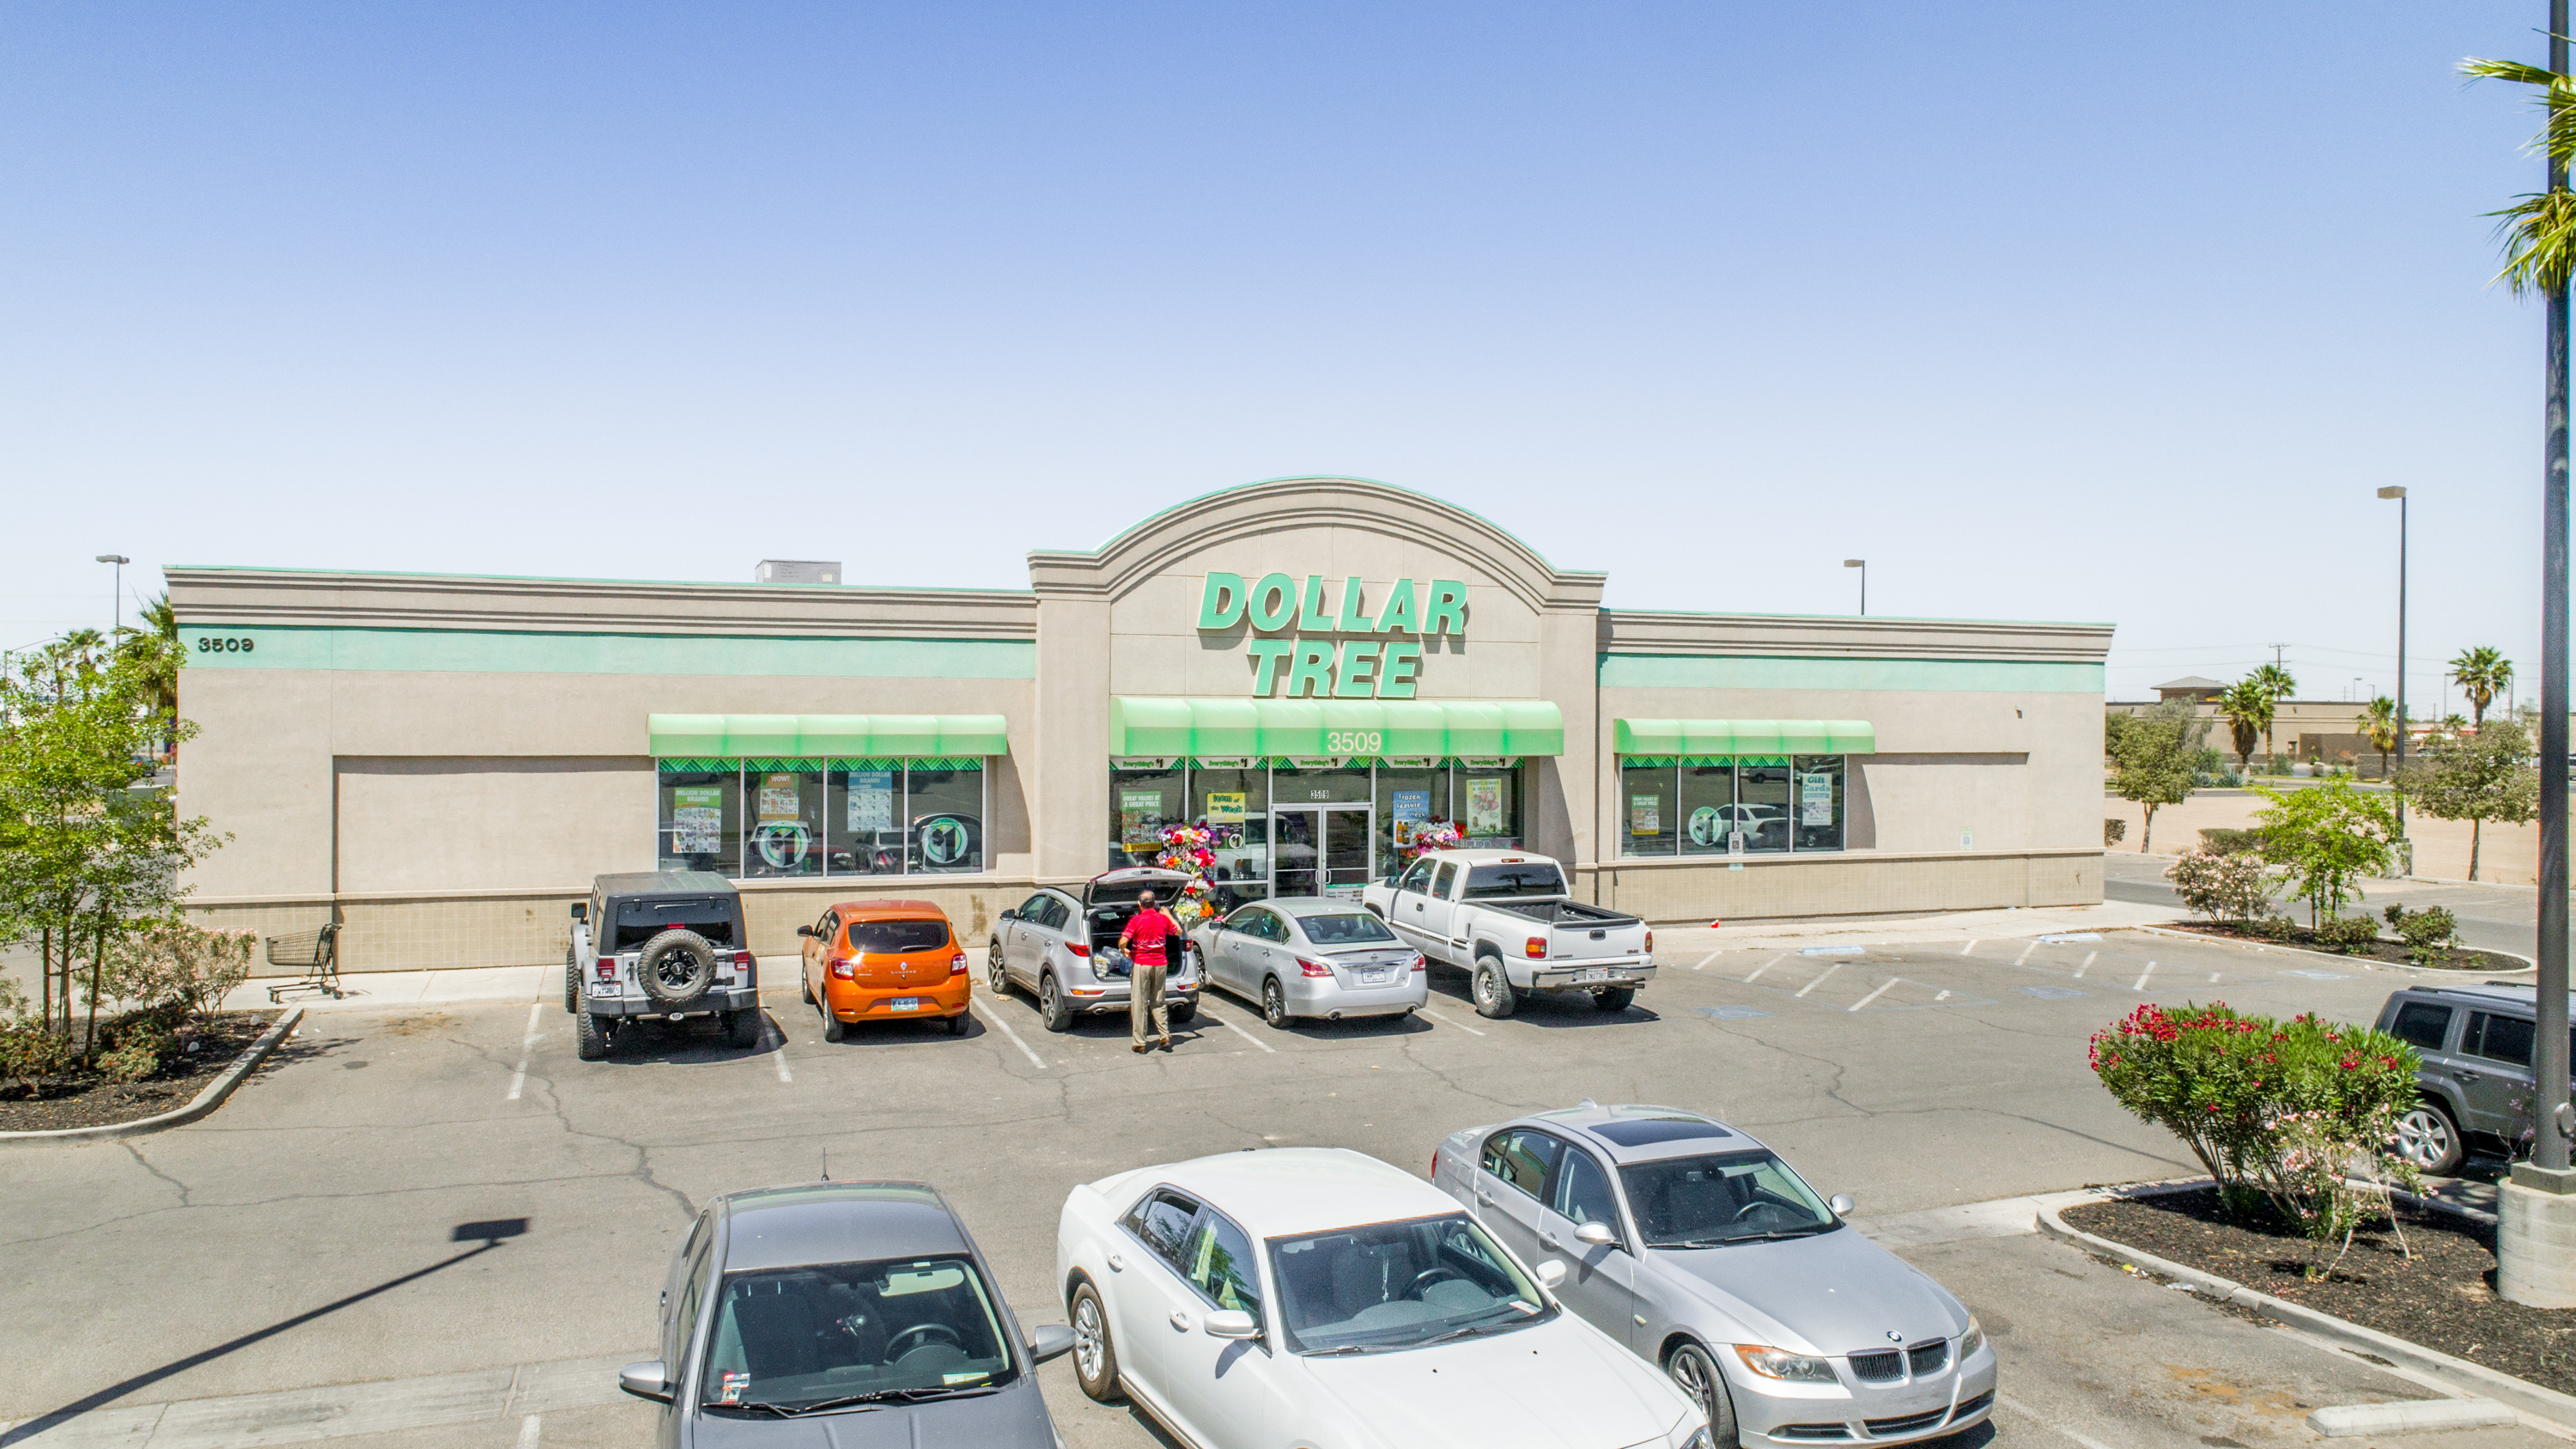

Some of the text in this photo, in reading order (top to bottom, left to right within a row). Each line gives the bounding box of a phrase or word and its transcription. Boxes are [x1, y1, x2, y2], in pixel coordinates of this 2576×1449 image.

[1197, 571, 1467, 635] DOLLAR
[198, 637, 254, 653] 3509
[1248, 639, 1421, 697] TREE
[1327, 732, 1382, 752] 3509
[1213, 795, 1232, 803] Item
[1311, 790, 1328, 799] 3509
[1220, 805, 1243, 813] Week
